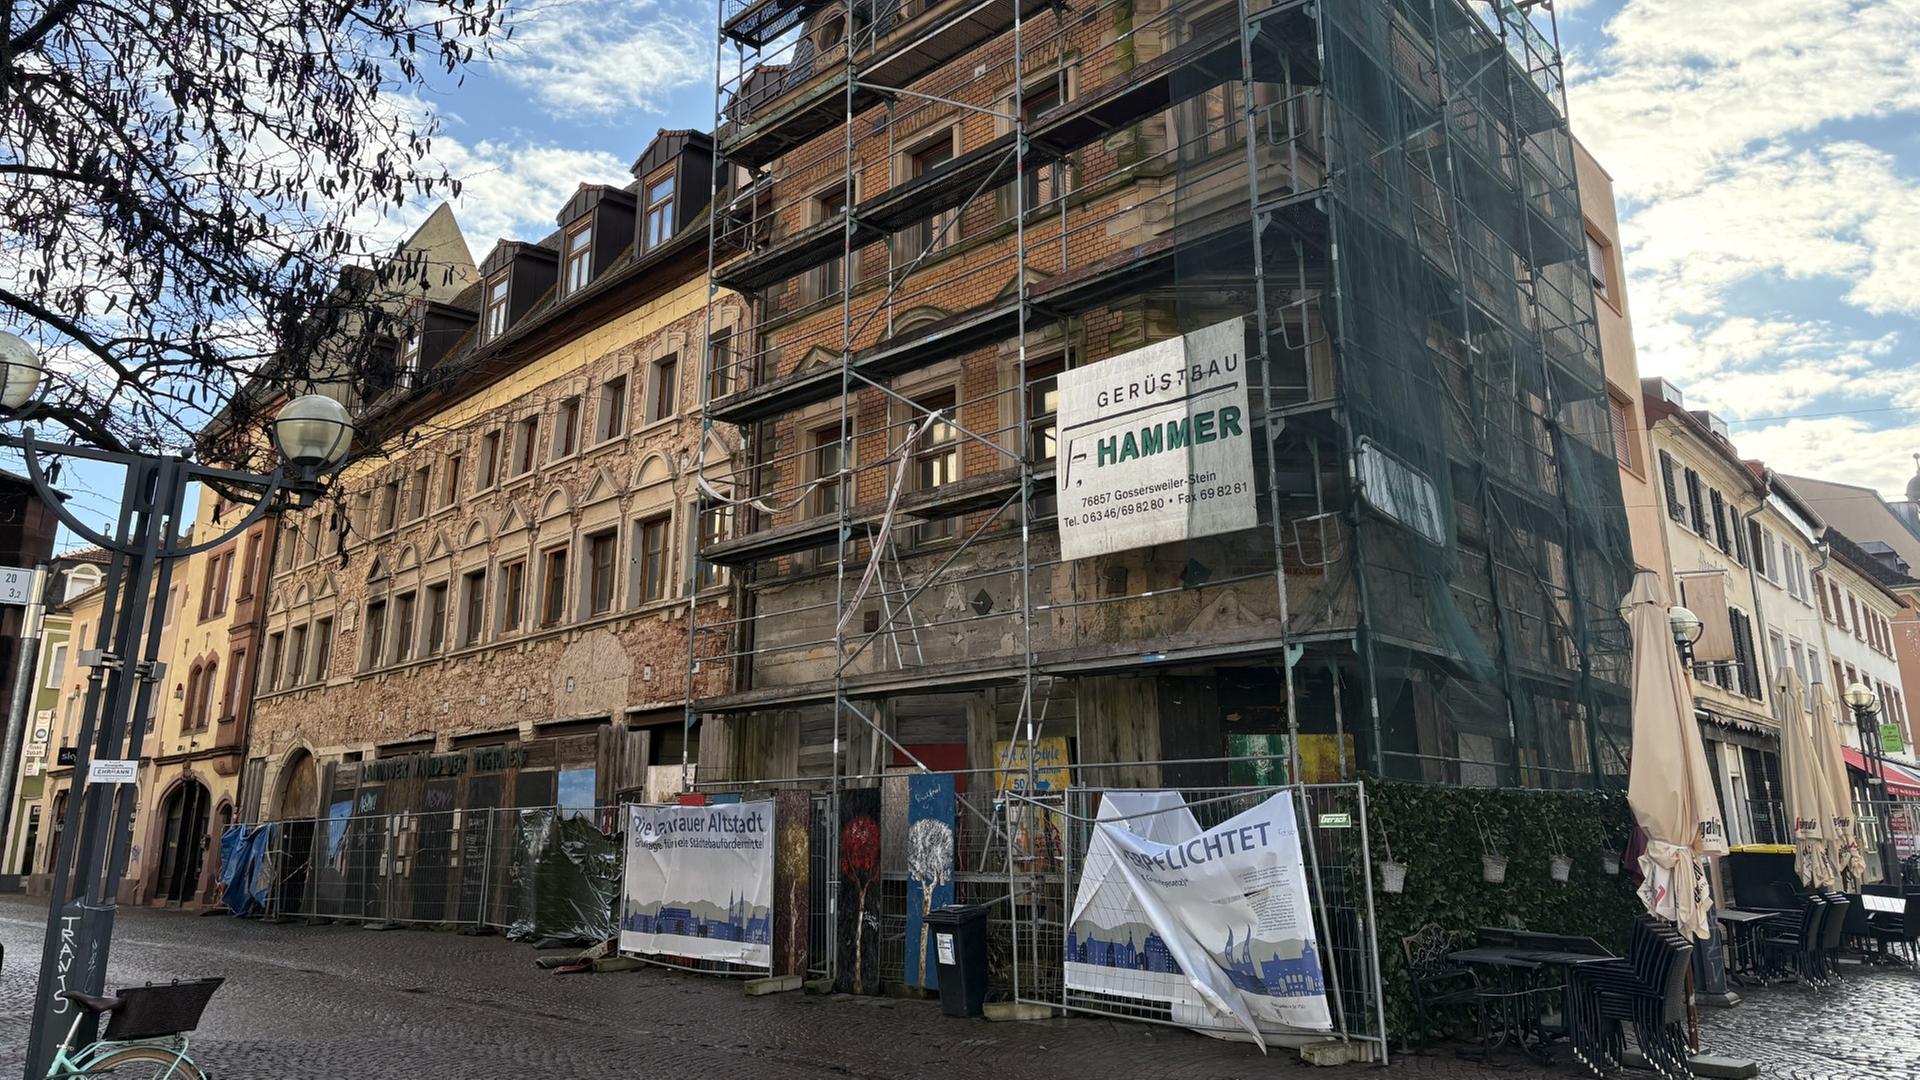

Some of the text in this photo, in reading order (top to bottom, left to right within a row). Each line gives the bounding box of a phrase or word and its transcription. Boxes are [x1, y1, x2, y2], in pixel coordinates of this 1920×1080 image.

[1097, 353, 1239, 408] GERÜSTBAU
[1097, 405, 1244, 468] HAMMER
[1081, 471, 1217, 508] 76857 Gossersweiler-Stein
[1063, 516, 1080, 528] Tel.
[1178, 492, 1198, 505] Fax
[5, 572, 18, 584] 20
[61, 751, 77, 762] sky
[1013, 778, 1026, 790] 50
[654, 815, 705, 837] Lanauer
[707, 812, 764, 833] Altstadt
[674, 838, 690, 849] iele
